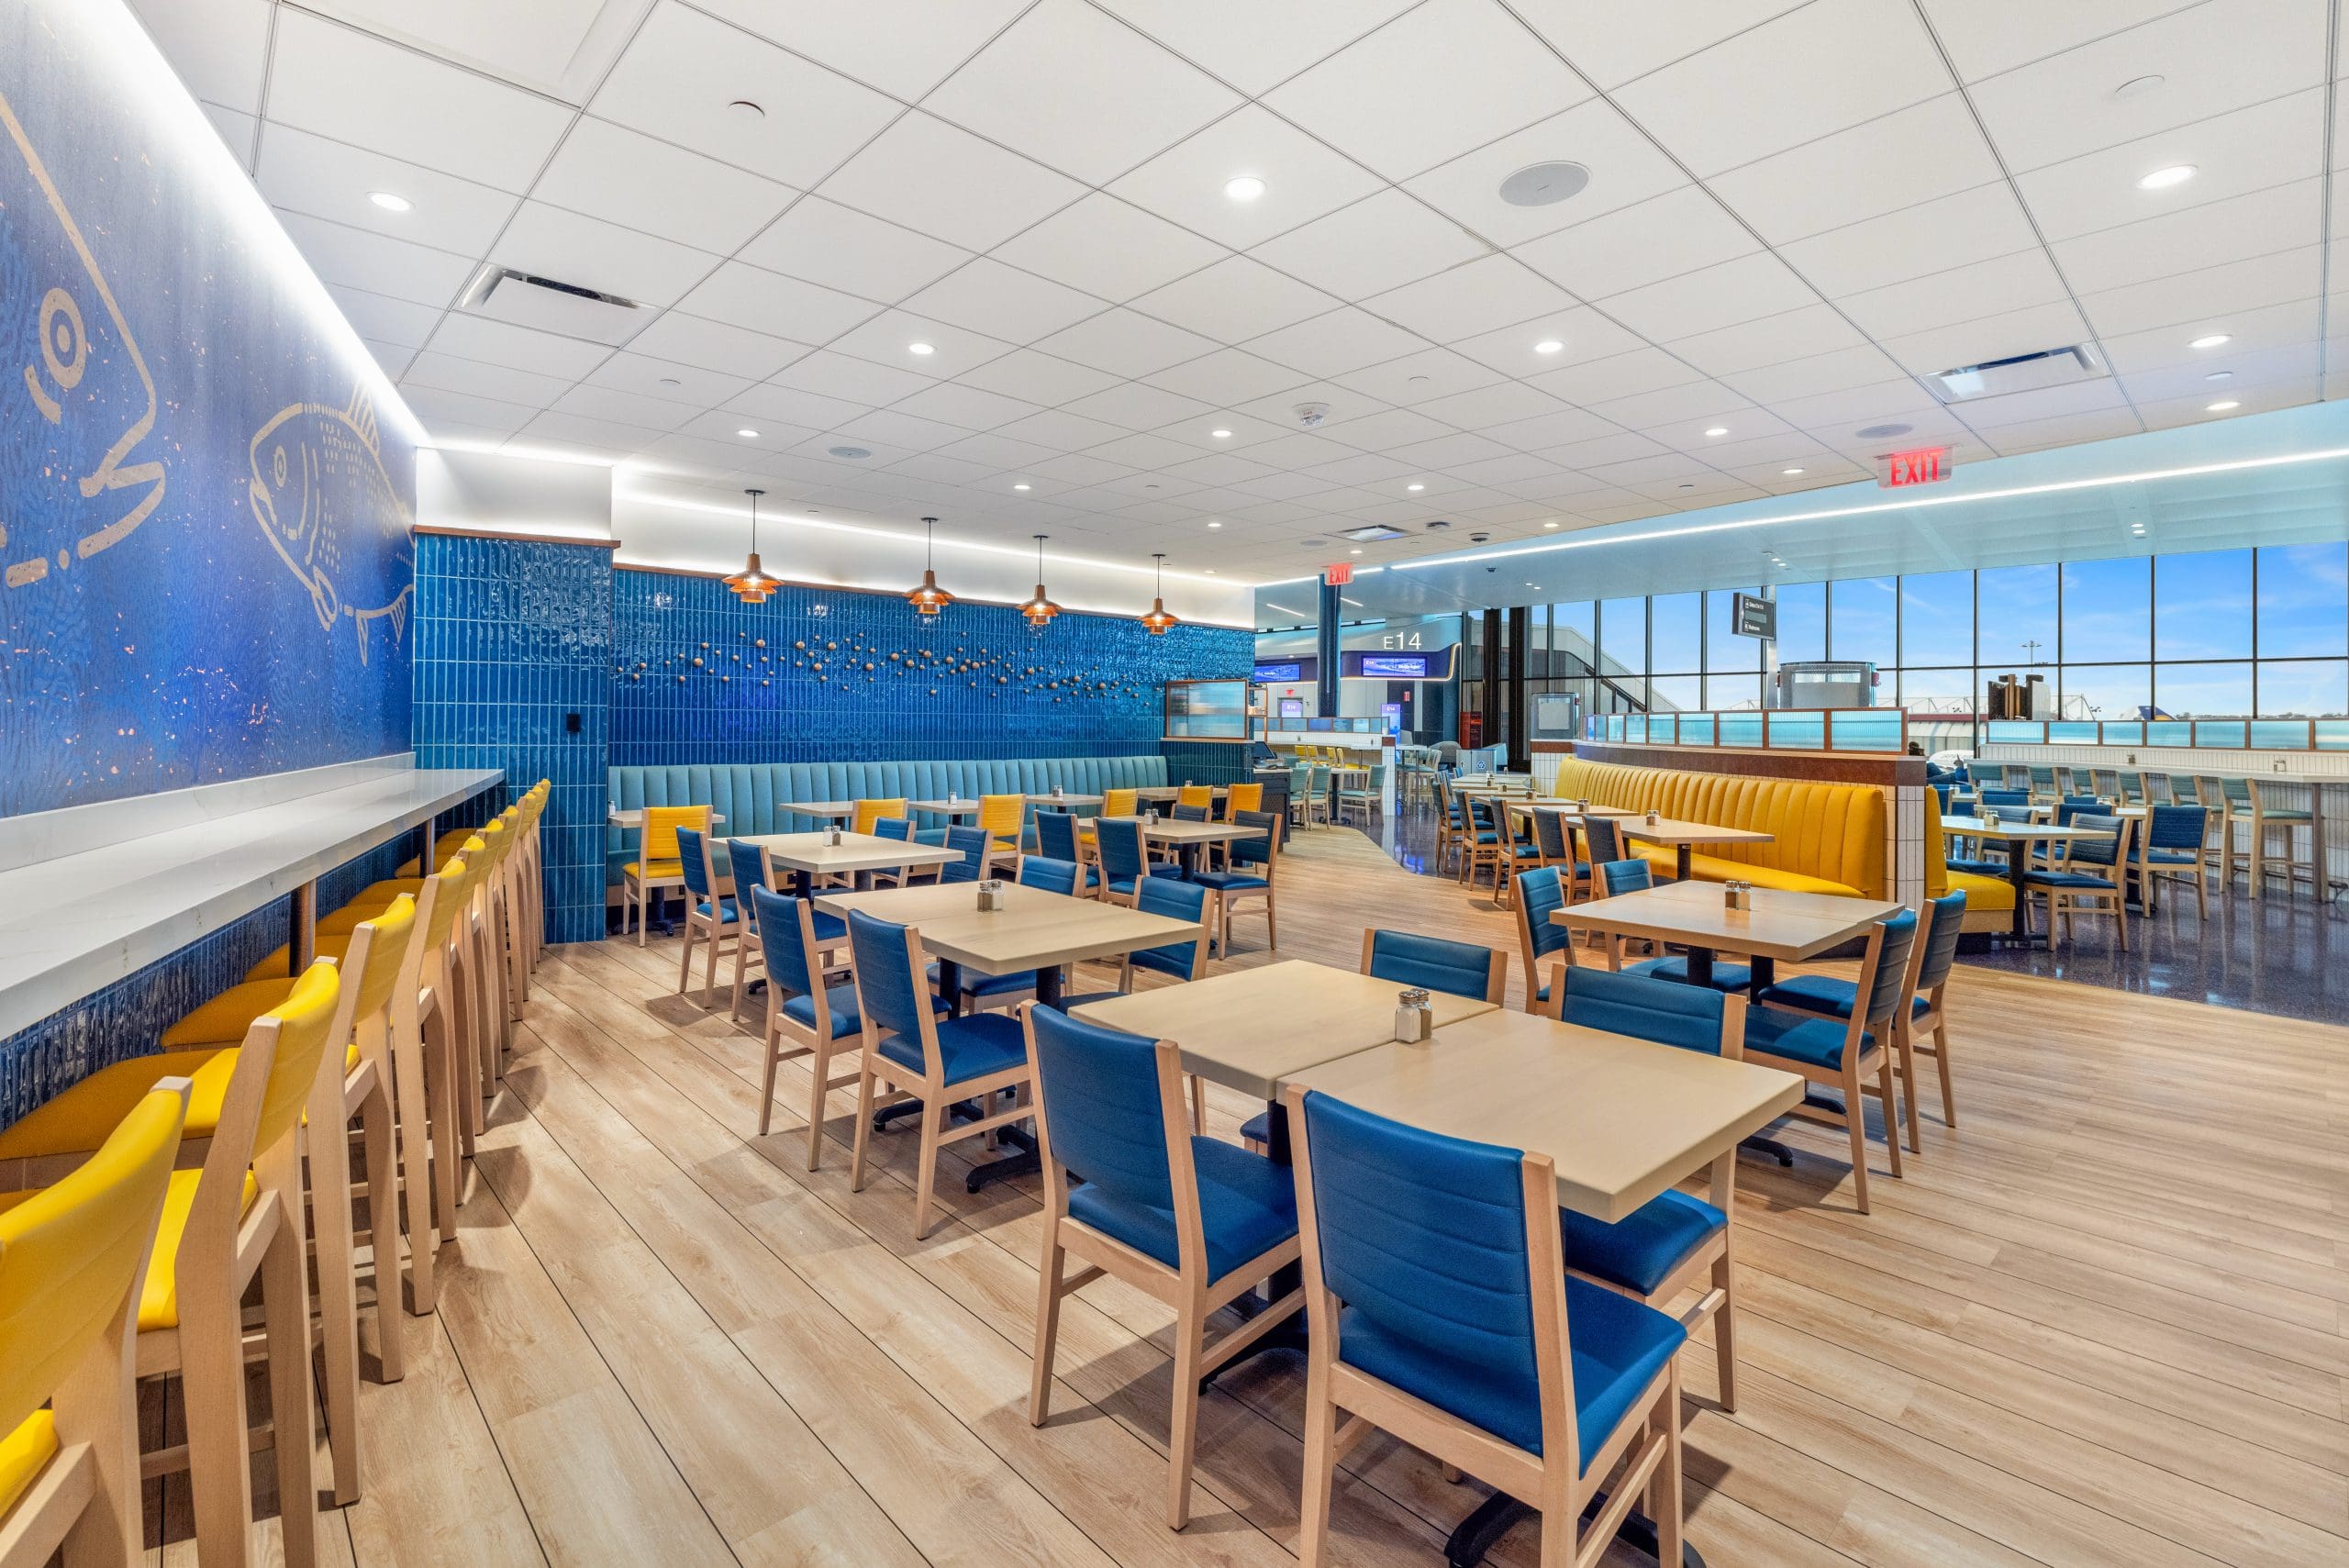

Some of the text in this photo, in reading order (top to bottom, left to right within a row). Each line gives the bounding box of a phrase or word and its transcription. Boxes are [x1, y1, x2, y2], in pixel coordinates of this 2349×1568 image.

[1891, 450, 1943, 485] EXIT
[1330, 564, 1350, 584] EXIT
[1384, 632, 1422, 650] E14
